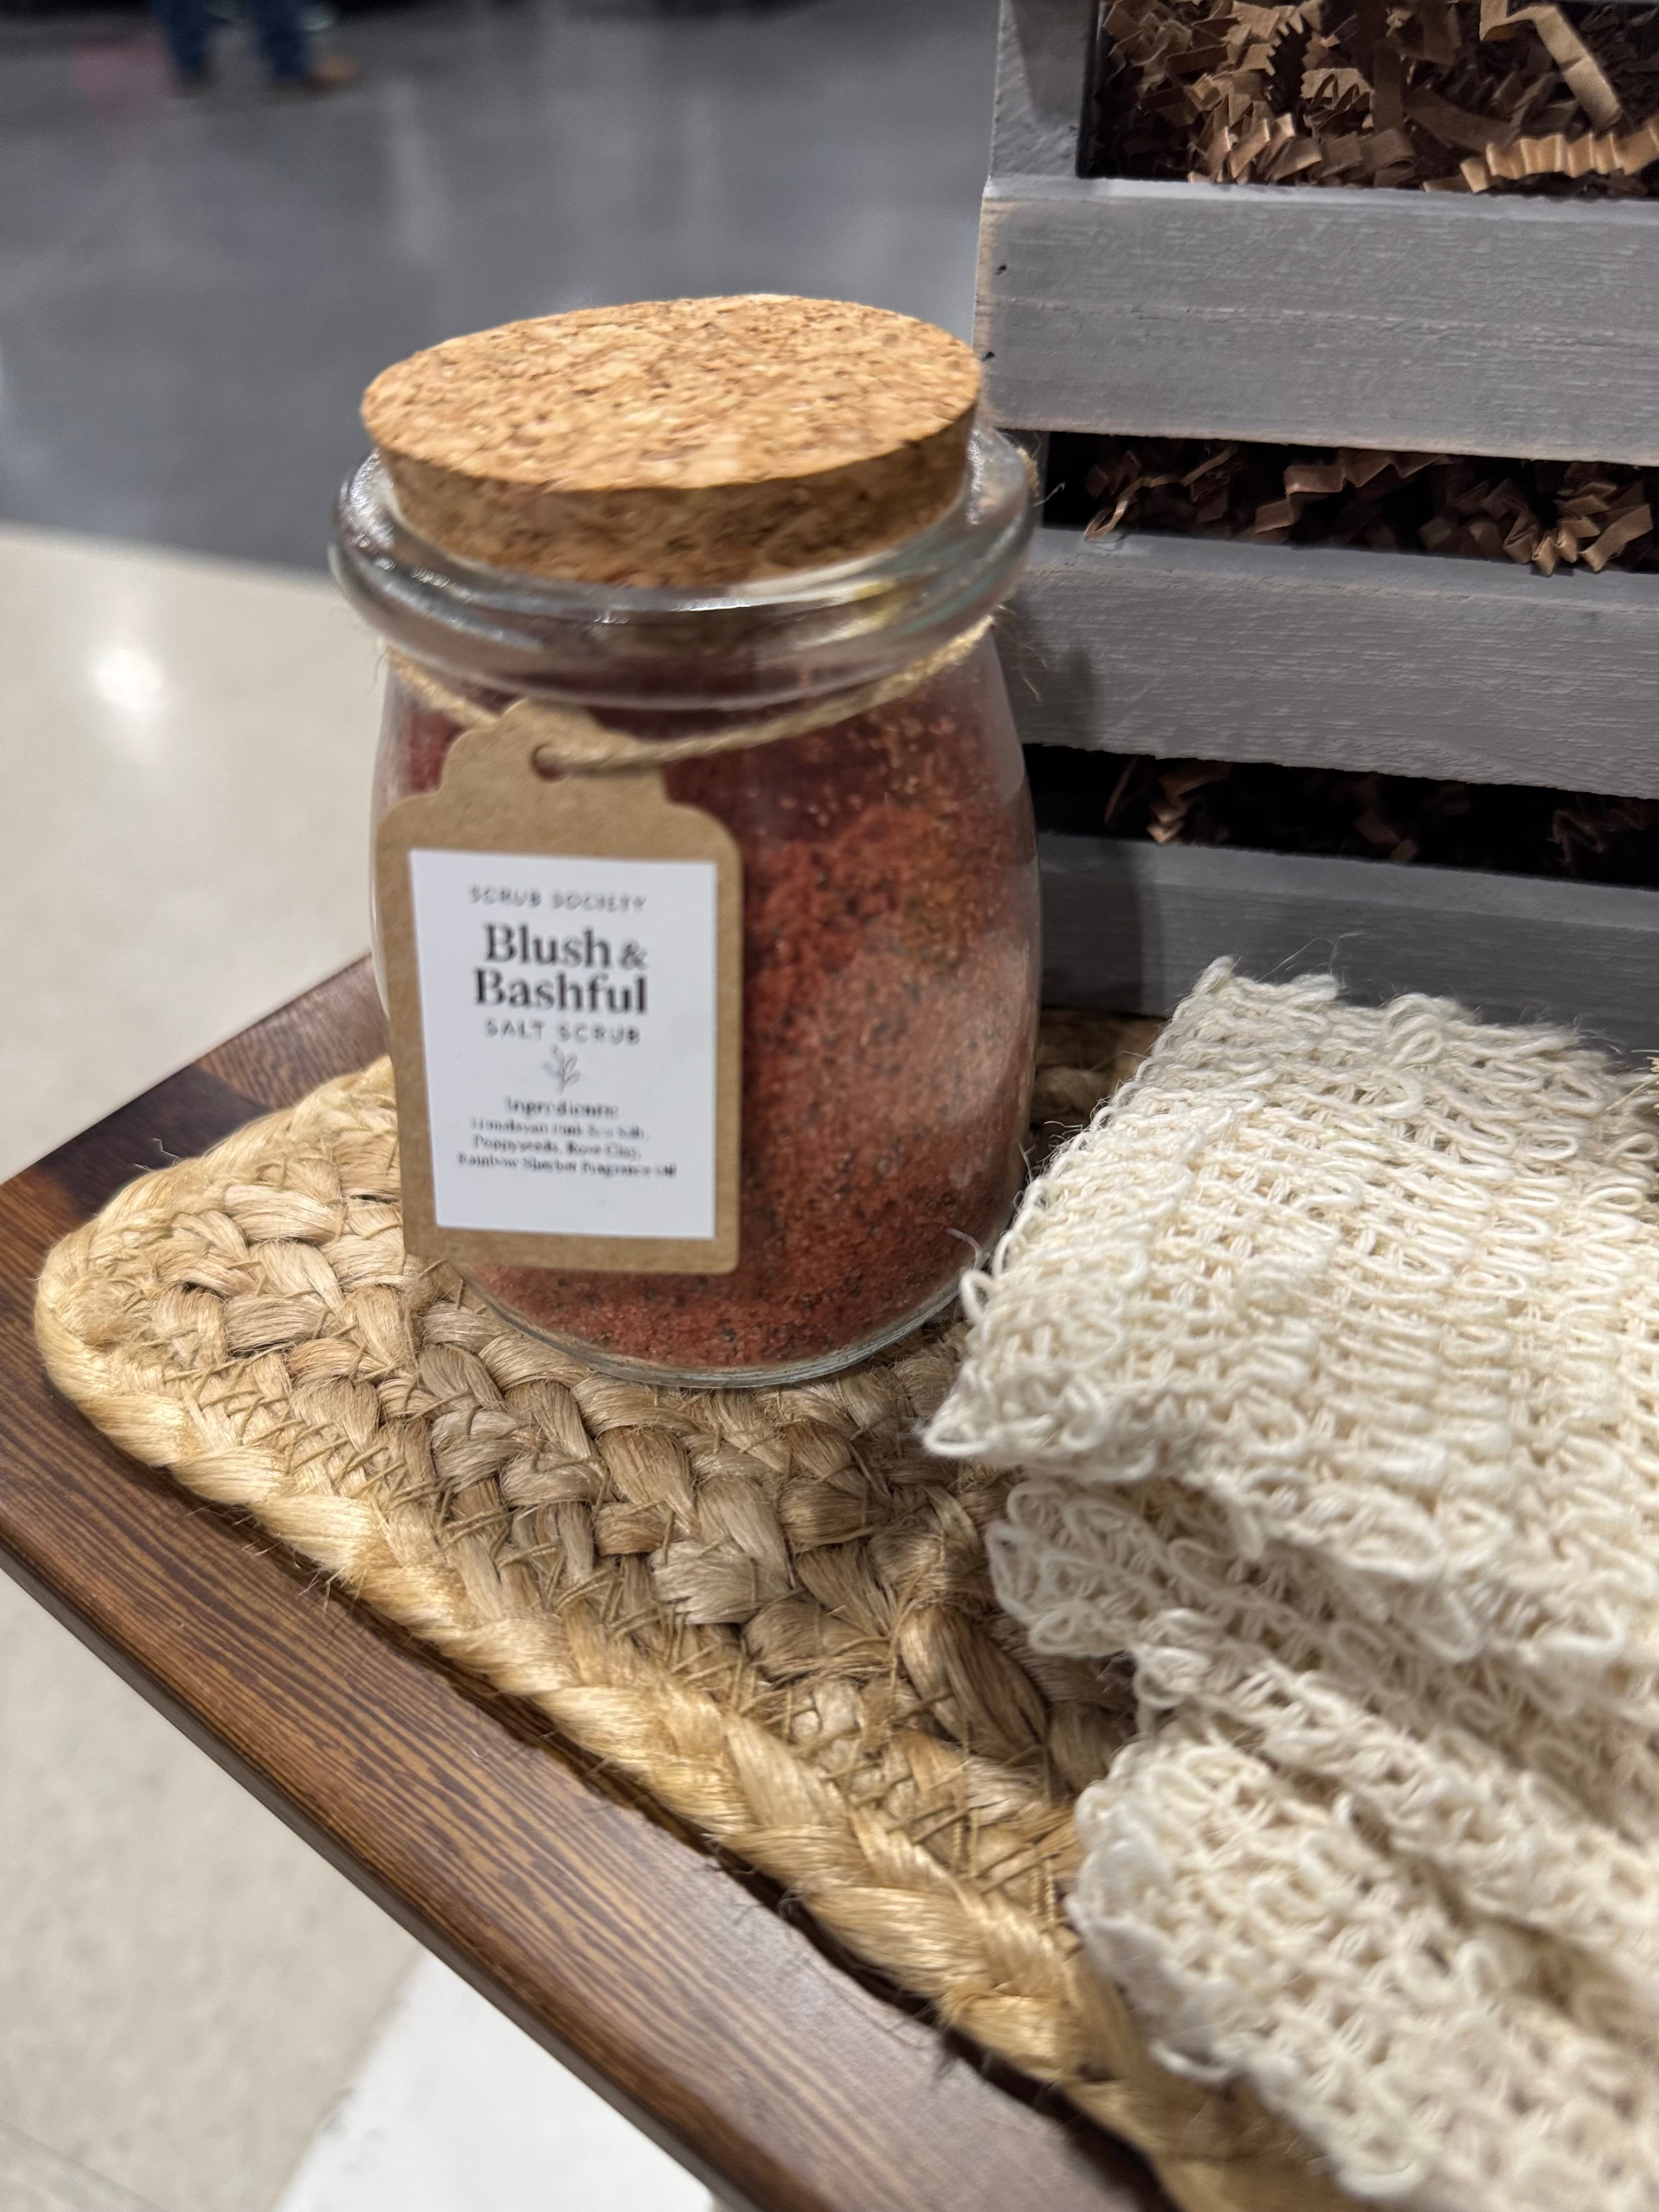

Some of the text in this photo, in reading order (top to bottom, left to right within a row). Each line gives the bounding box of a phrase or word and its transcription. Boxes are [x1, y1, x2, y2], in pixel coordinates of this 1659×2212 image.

[471, 885, 646, 912] SCRUB SOCIETY
[485, 923, 648, 969] Blush &
[475, 969, 648, 1014] Bashful
[485, 1019, 640, 1045] SALT SCRUB
